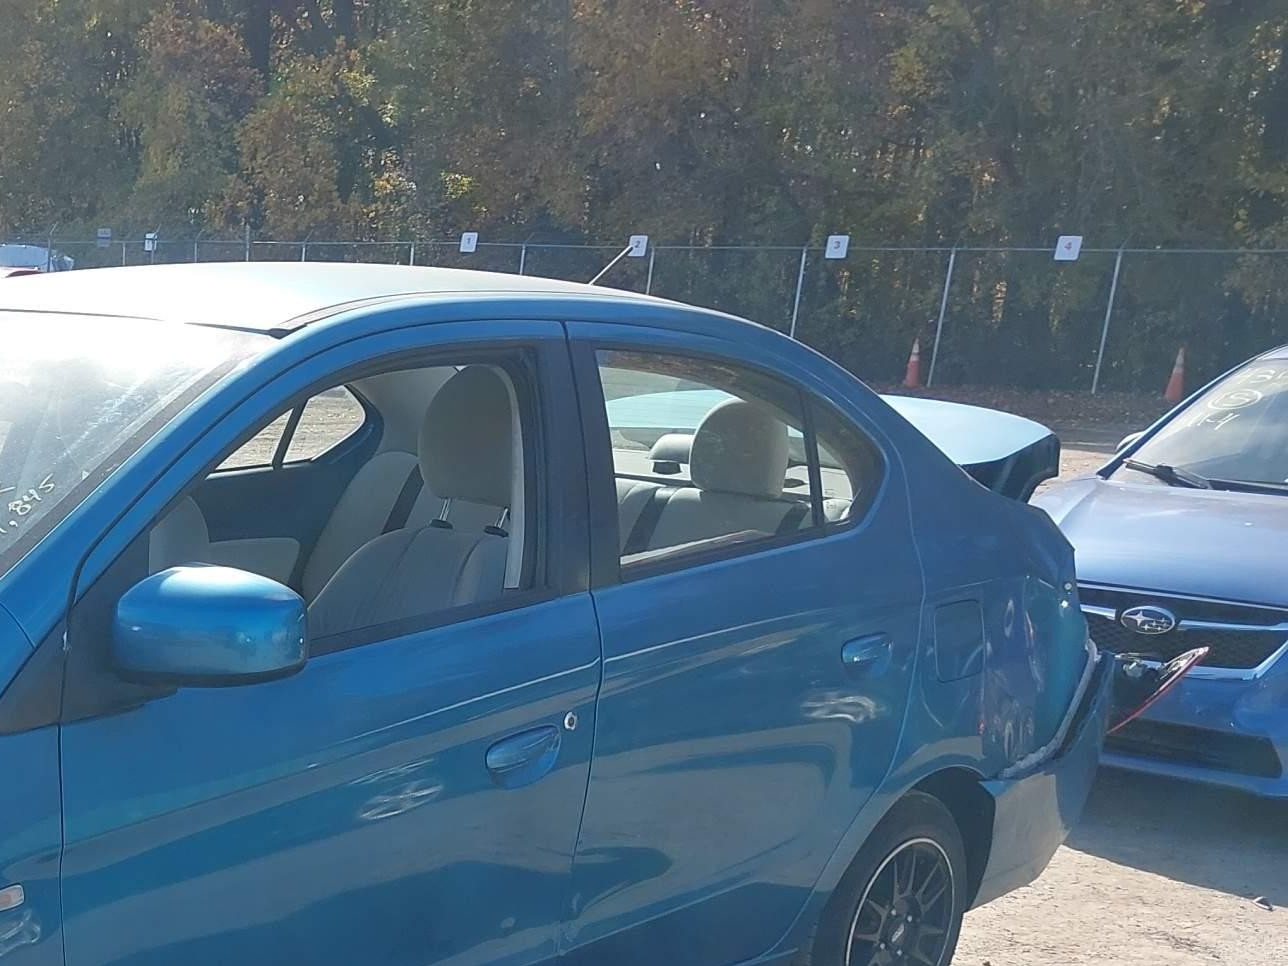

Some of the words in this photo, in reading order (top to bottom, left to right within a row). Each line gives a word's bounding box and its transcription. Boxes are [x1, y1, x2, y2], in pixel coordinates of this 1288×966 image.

[634, 240, 642, 250] 2
[832, 240, 841, 250] 3
[1063, 241, 1073, 251] 4
